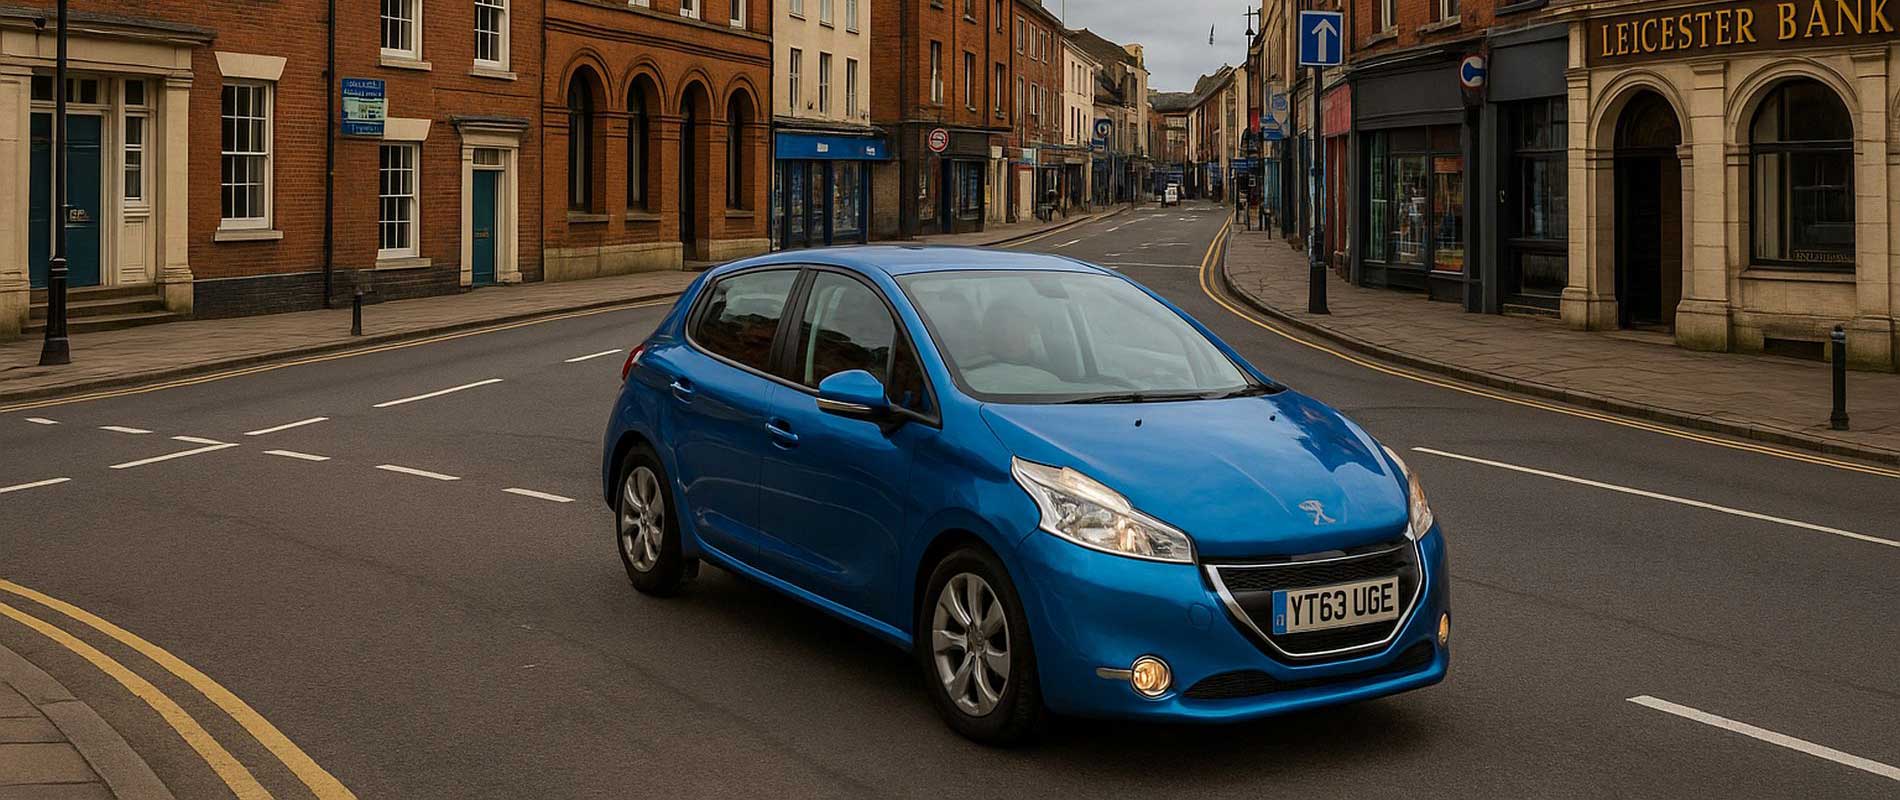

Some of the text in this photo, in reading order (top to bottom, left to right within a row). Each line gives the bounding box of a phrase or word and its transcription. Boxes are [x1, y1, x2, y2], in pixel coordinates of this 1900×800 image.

[1601, 0, 1894, 57] LEICESTER BANK
[1291, 582, 1394, 626] YT63 UGE
